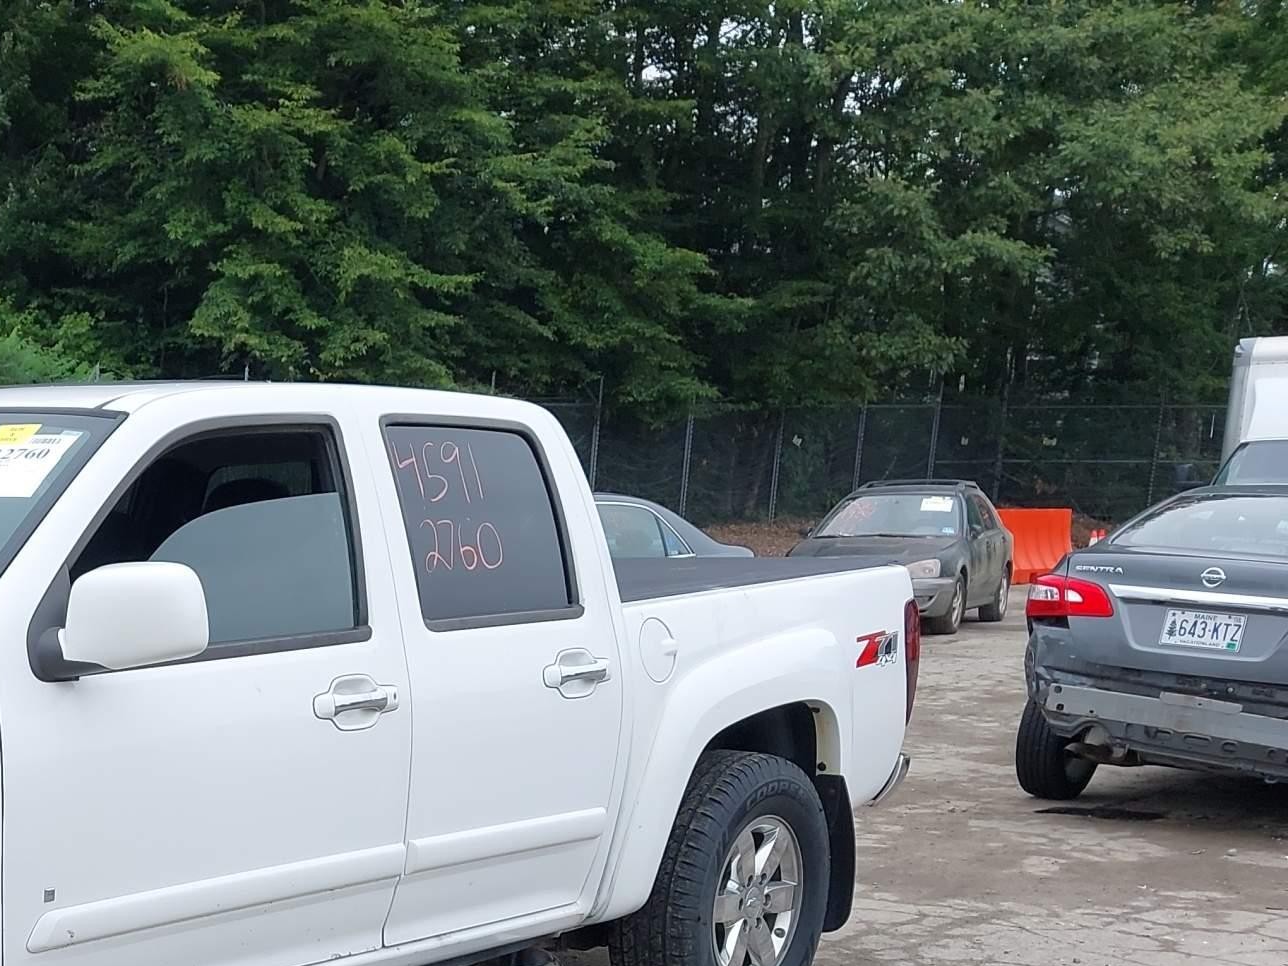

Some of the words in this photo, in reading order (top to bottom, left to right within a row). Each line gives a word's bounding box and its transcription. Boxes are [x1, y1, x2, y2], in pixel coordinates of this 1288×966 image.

[391, 441, 485, 504] 4591
[419, 518, 504, 573] 2760
[1075, 564, 1124, 576] SENTRA
[1193, 612, 1218, 622] MAINE
